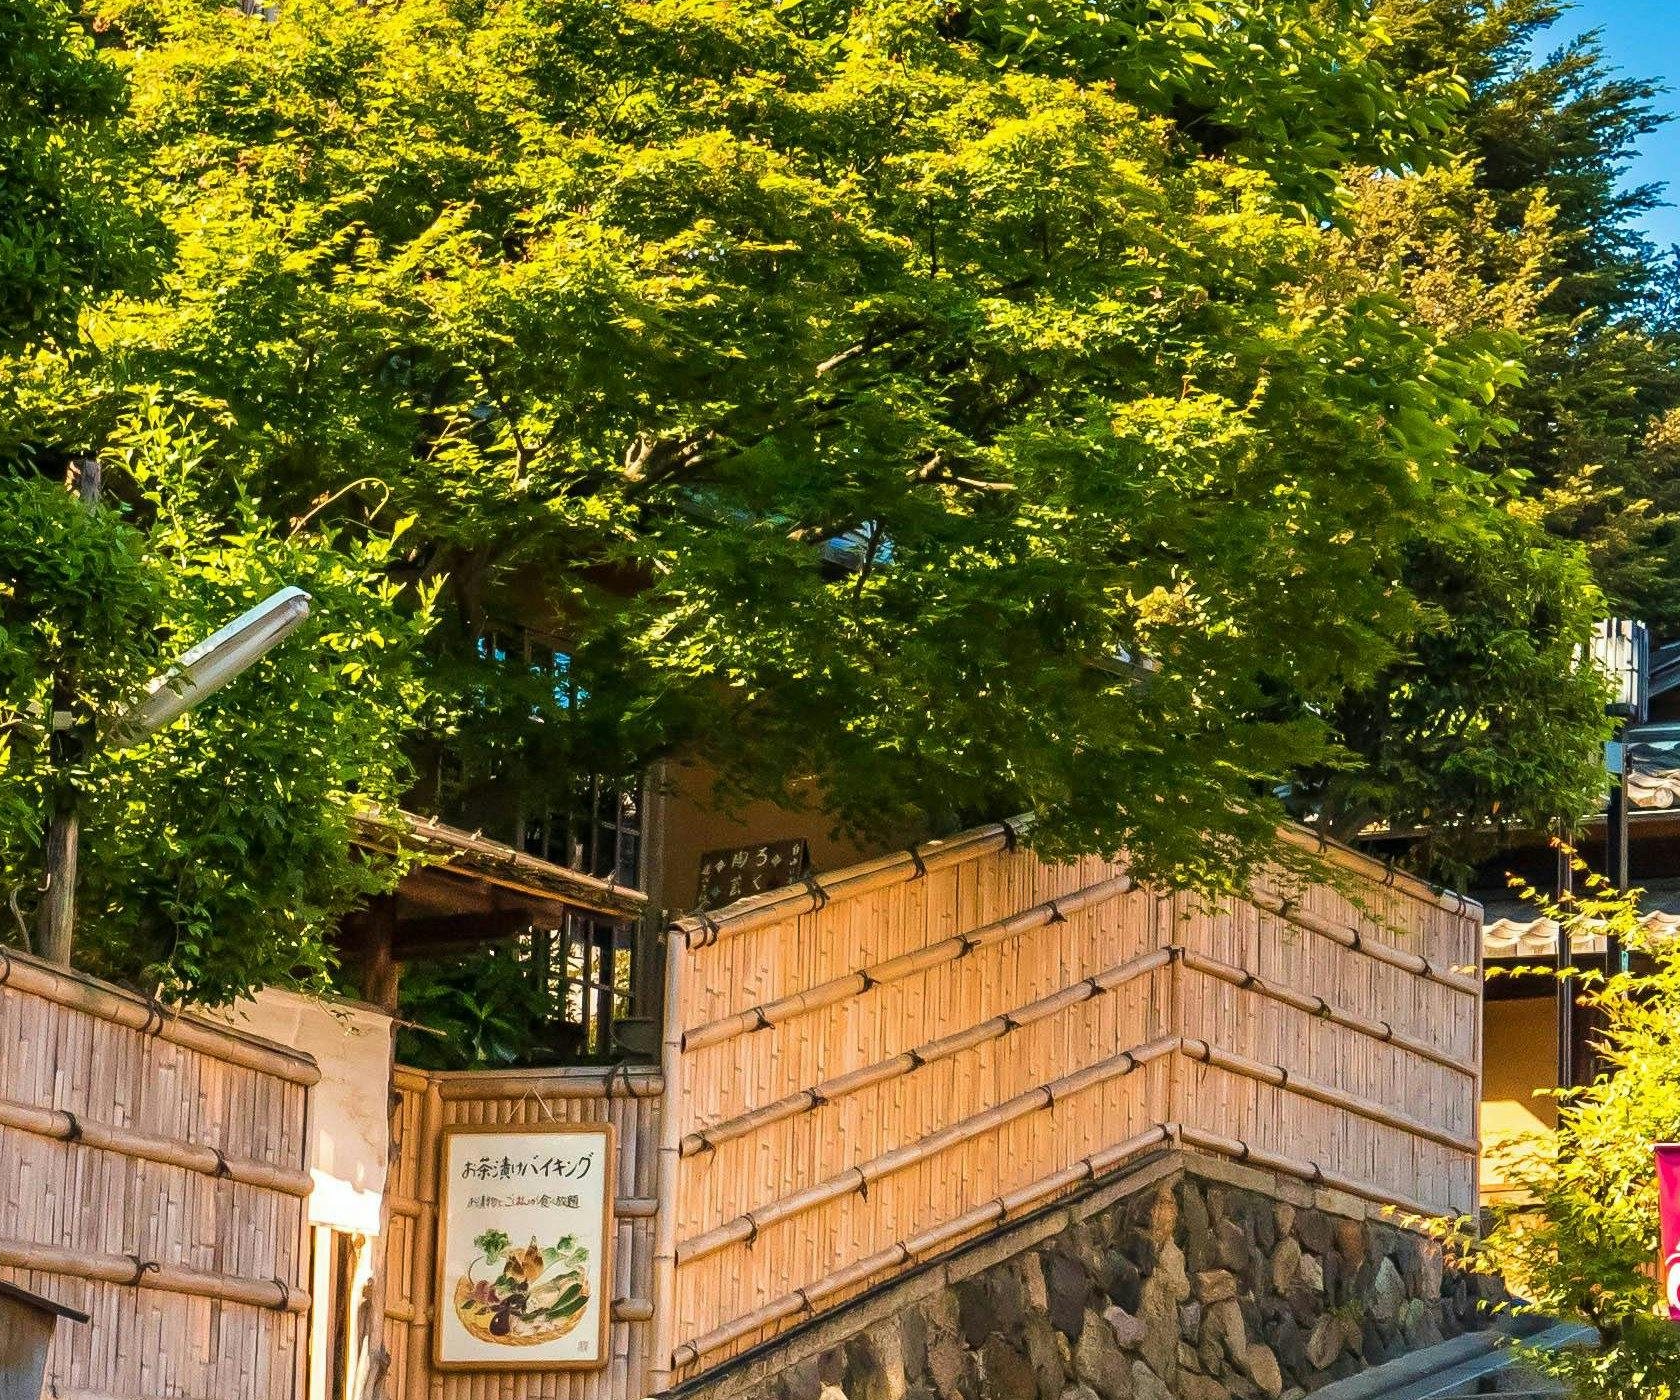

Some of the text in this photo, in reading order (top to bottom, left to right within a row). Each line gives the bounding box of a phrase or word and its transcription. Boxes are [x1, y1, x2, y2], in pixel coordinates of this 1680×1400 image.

[461, 1151, 594, 1181] お茶漬けバイキング
